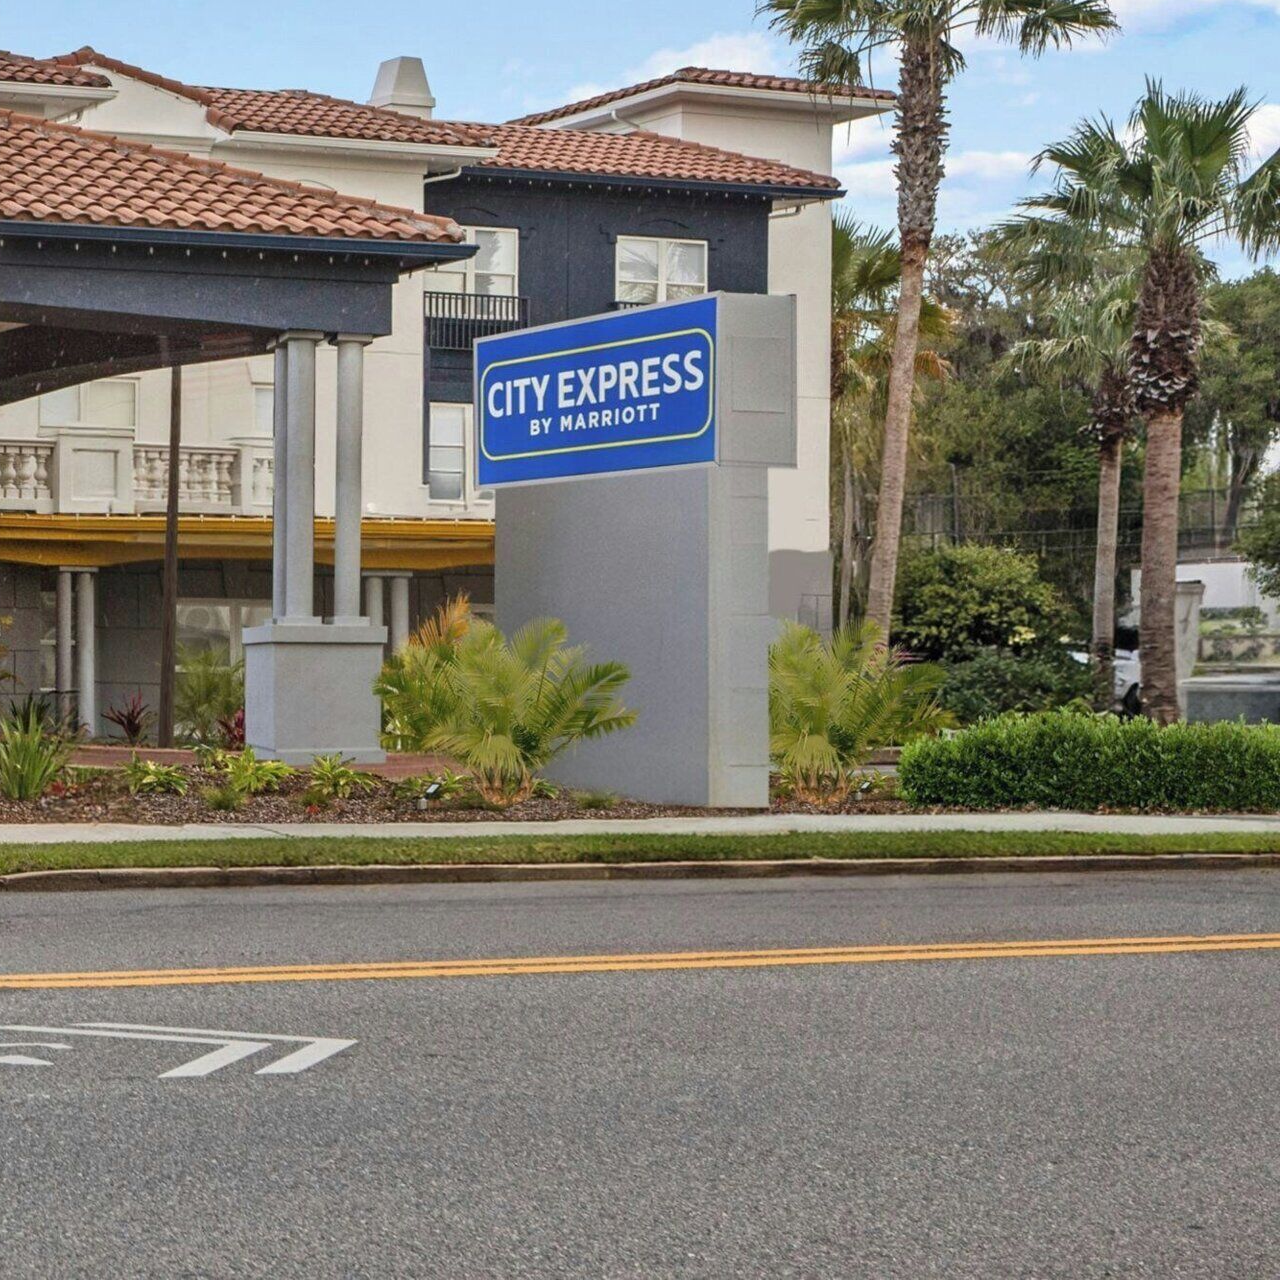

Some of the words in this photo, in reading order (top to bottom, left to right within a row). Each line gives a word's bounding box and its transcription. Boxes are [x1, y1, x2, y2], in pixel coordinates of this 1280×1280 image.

[486, 375, 550, 418] CITY
[558, 350, 704, 408] EXPRESS
[530, 417, 552, 436] BY
[560, 403, 661, 432] MARRIOTT
